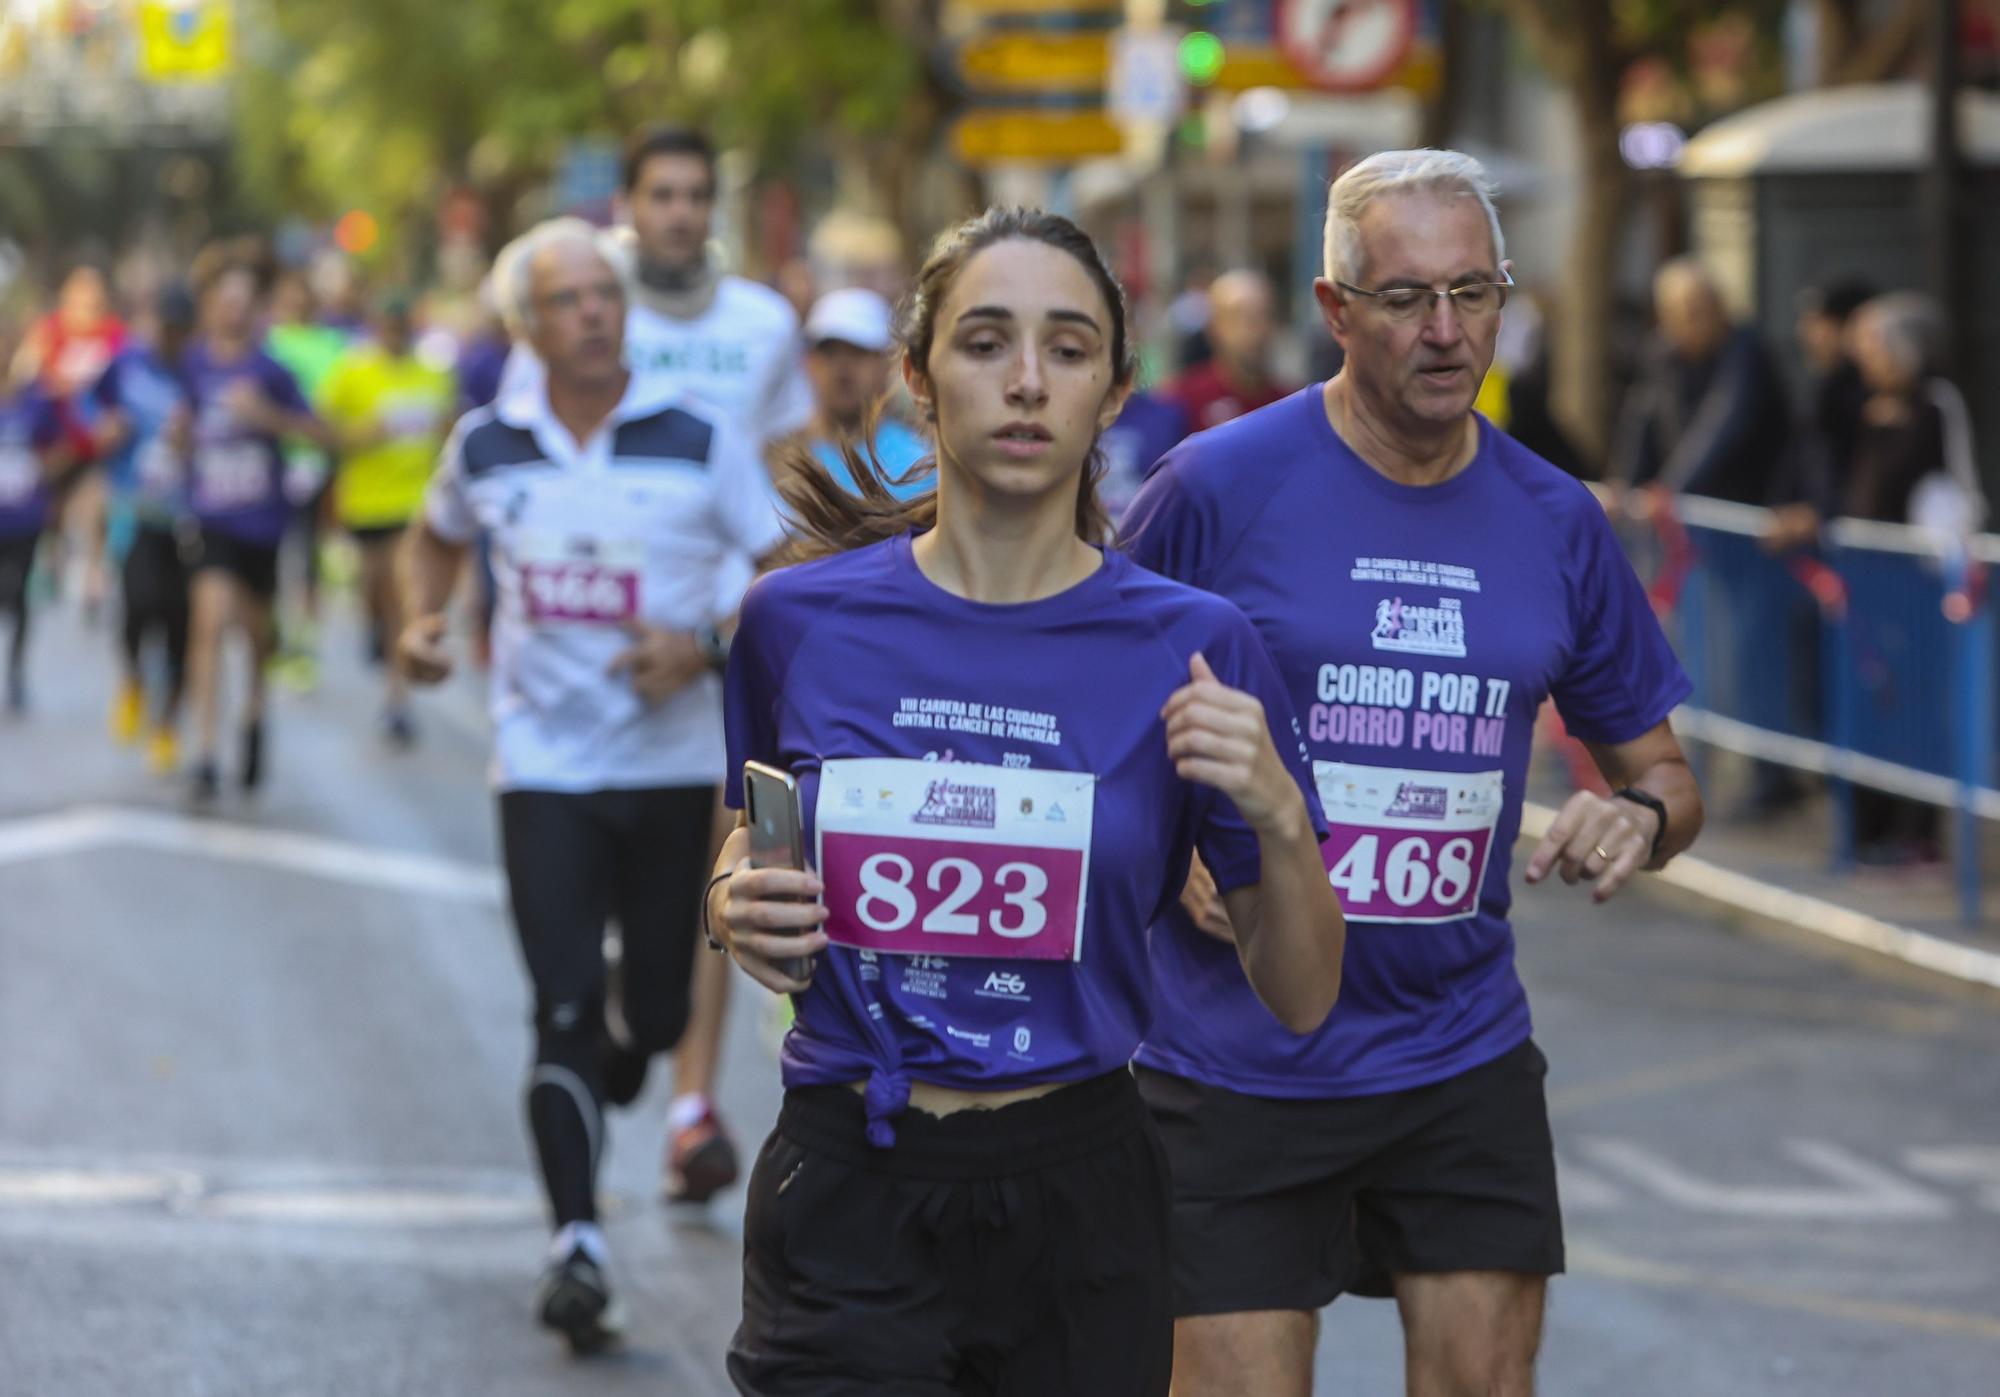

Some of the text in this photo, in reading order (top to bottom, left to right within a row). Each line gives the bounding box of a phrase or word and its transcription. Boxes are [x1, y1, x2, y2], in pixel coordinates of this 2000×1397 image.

[900, 698, 1057, 730] VIII CARRERA DE LAS CIUDADES
[1317, 663, 1511, 718] CORRO POR TI
[893, 711, 933, 728] CONTRA
[934, 714, 947, 729] EL
[991, 720, 1006, 737] DE
[1308, 703, 1405, 748] CORRO
[1412, 711, 1467, 754] POR
[855, 852, 1049, 939] 823
[1329, 834, 1474, 908] 468
[983, 971, 1026, 995] AEG
